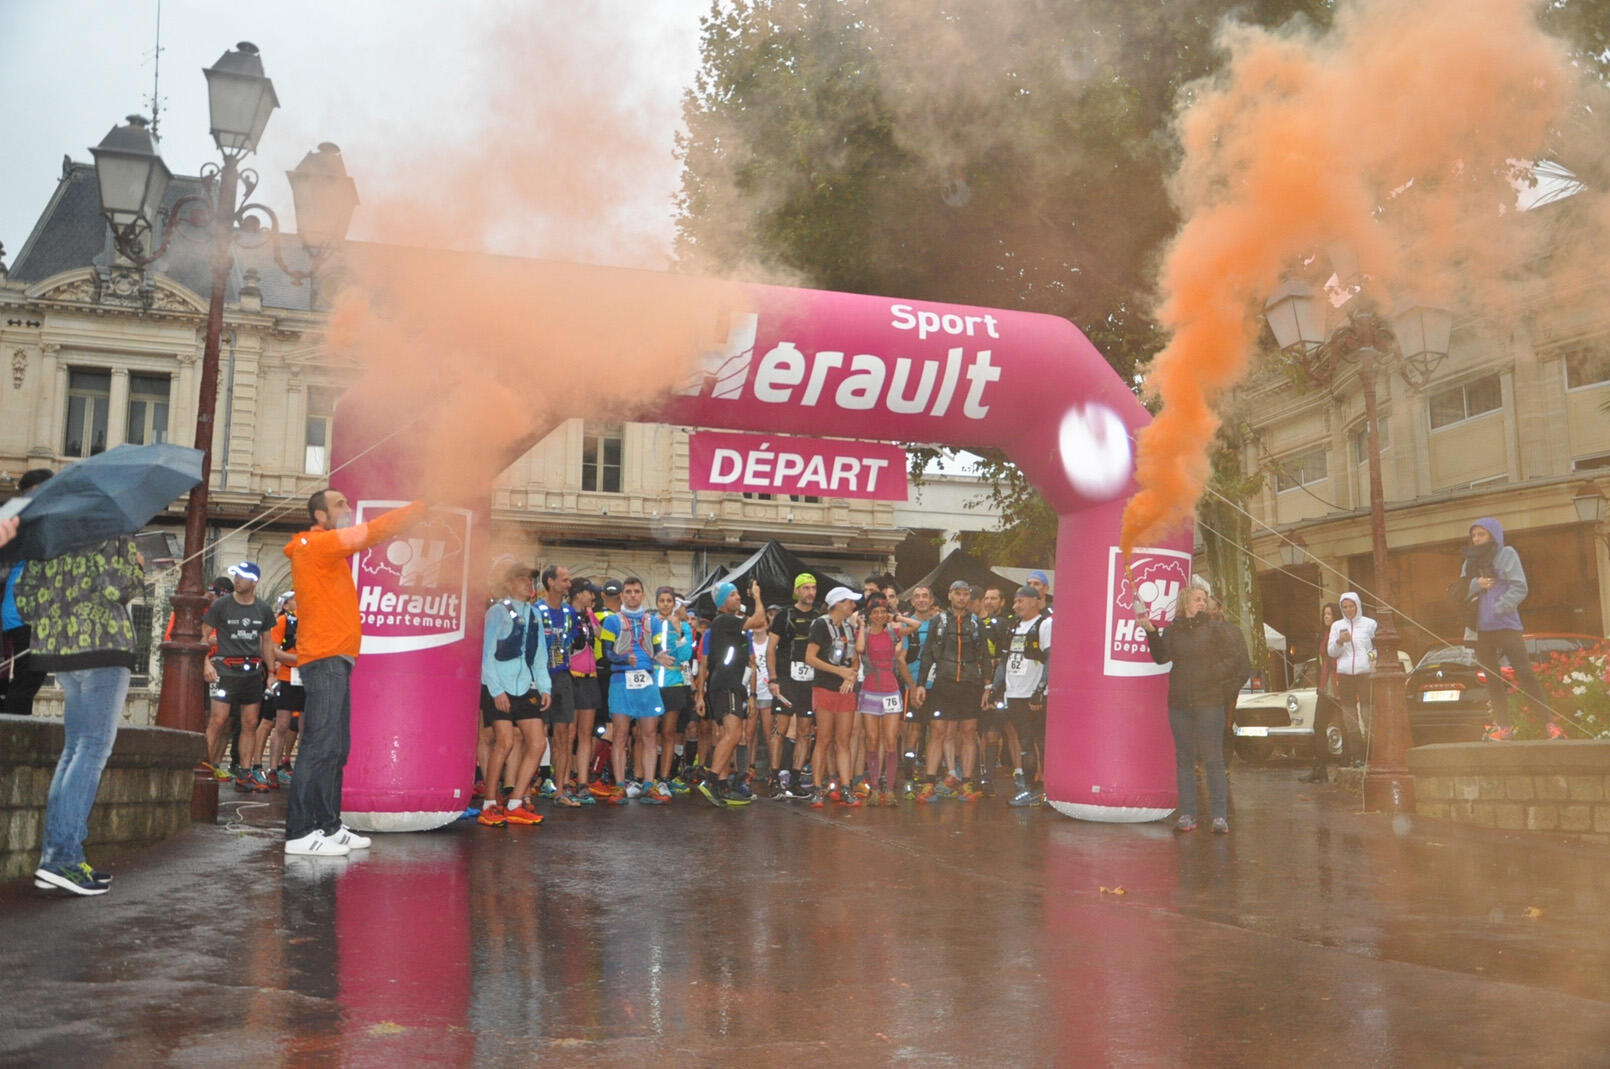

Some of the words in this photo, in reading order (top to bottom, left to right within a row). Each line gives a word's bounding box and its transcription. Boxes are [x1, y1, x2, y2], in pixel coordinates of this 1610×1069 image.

[890, 304, 1000, 339] Sport
[709, 443, 889, 492] DÉPART
[1011, 660, 1021, 670] 62
[798, 665, 809, 676] 57
[633, 673, 646, 683] 82
[885, 697, 898, 707] 76
